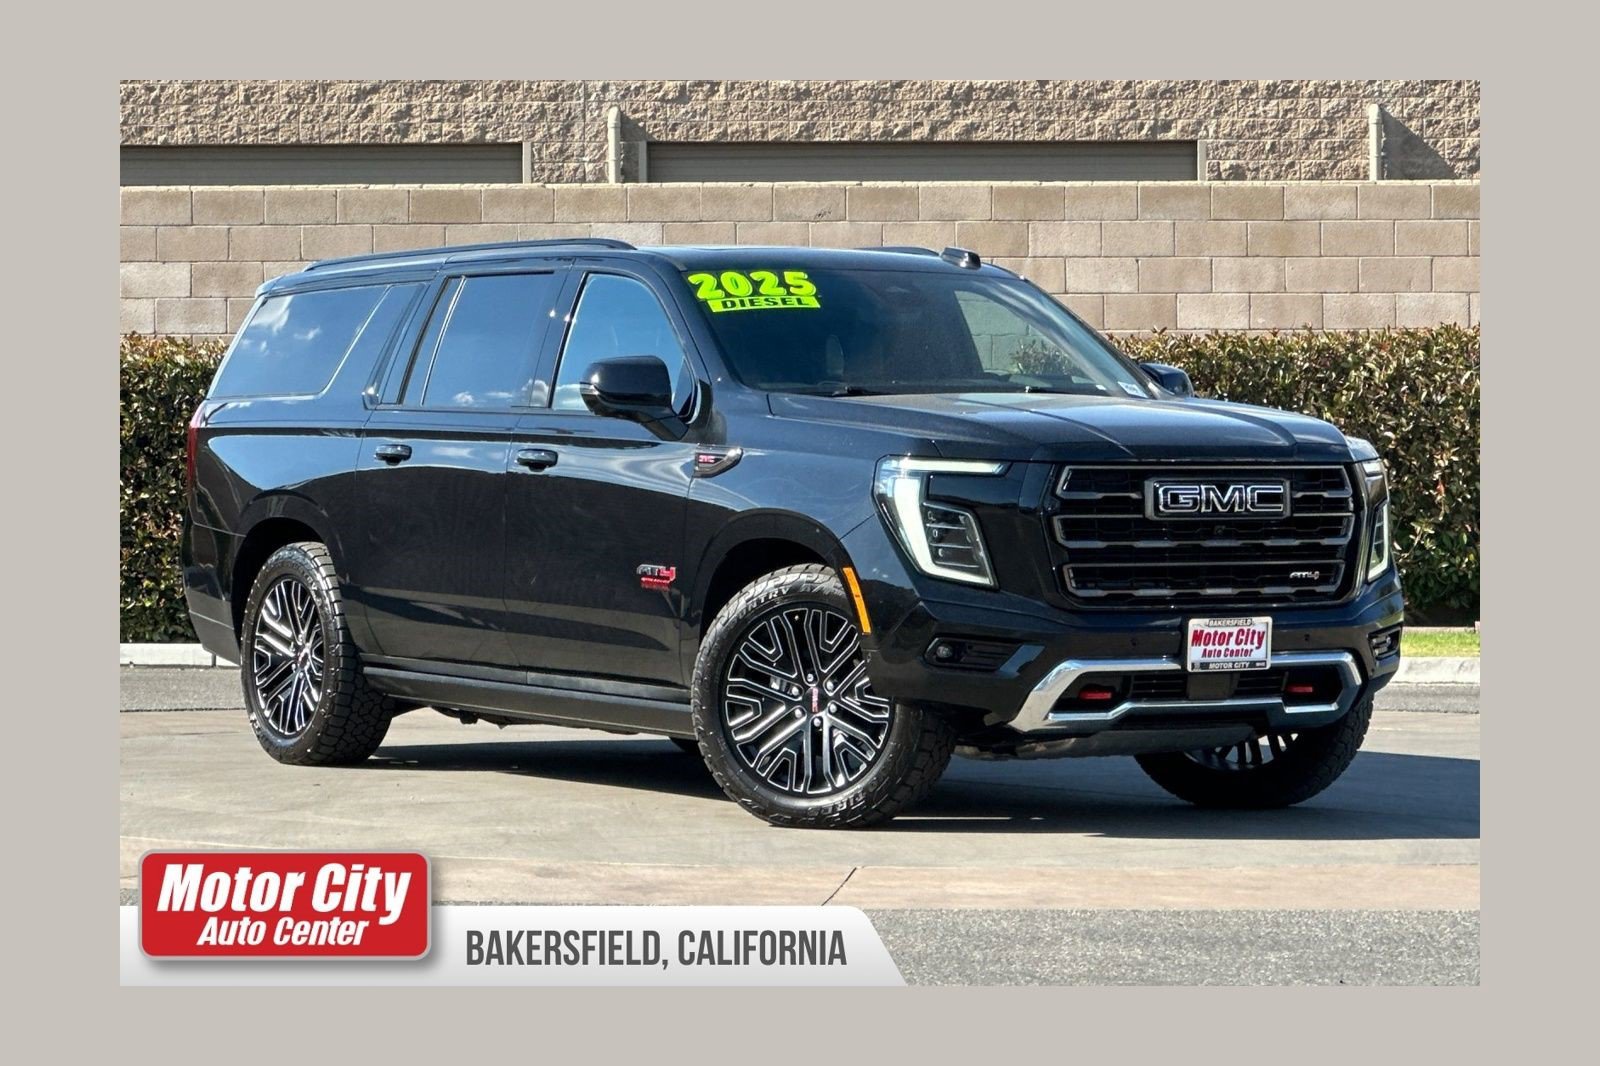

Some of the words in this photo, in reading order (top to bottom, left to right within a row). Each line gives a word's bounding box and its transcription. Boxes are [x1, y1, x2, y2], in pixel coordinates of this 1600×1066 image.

[688, 271, 816, 299] 2025
[721, 297, 810, 309] DIESEL
[1158, 484, 1284, 513] GMC
[1209, 618, 1252, 626] BAKERSFIELD
[1191, 629, 1234, 647] Motor
[1234, 628, 1265, 650] City
[1201, 648, 1222, 658] Auto
[1223, 647, 1253, 658] Center
[1208, 661, 1233, 669] MOTOR
[1233, 661, 1250, 669] CITY
